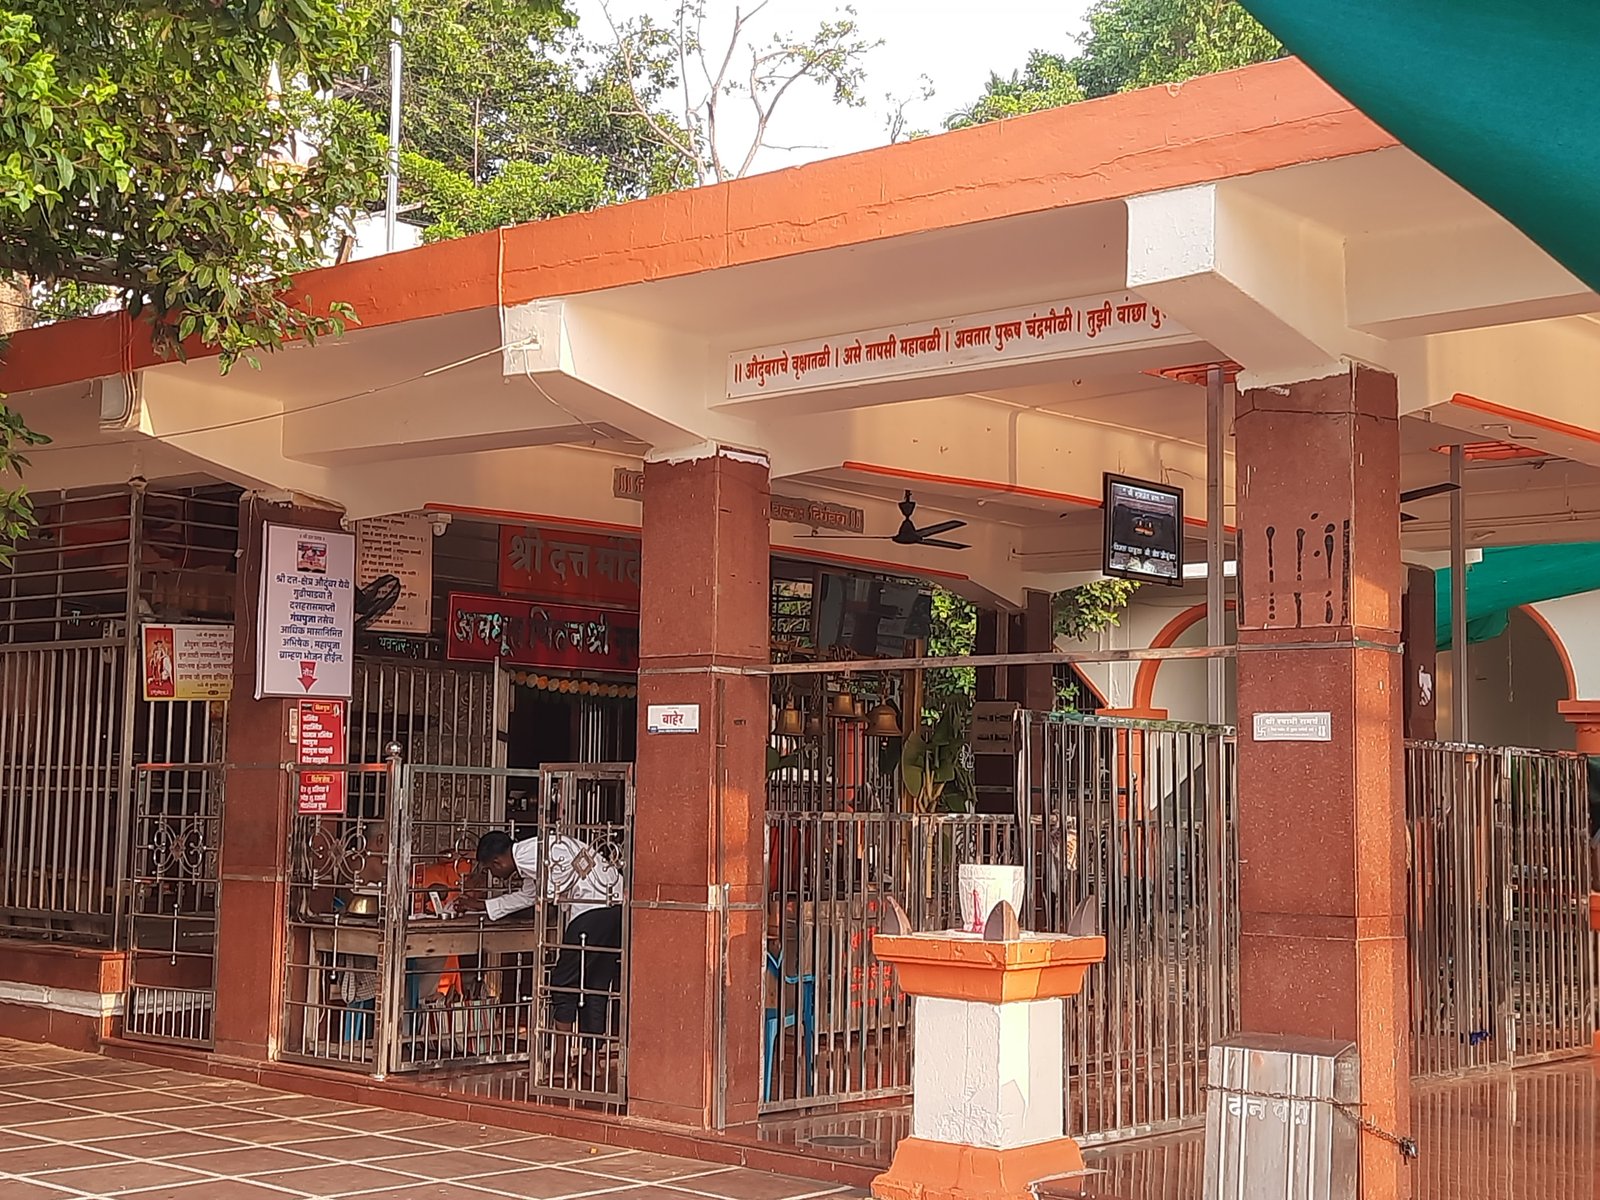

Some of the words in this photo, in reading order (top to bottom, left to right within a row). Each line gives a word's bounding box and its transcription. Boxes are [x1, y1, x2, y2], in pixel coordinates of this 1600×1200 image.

[791, 344, 831, 379] वृक्षातळी
[843, 339, 862, 365] असे
[865, 334, 896, 361] तापसी
[900, 327, 941, 358] महाबळी
[954, 326, 991, 349] अवतार
[1025, 307, 1072, 339] चंद्रमौळी
[1087, 300, 1112, 338] तुझी
[1116, 296, 1147, 325] वांछा
[508, 528, 544, 574] श्री
[548, 541, 591, 581] दत्त
[276, 573, 286, 583] श्री
[327, 589, 332, 599] ते
[317, 614, 334, 624] तसेच
[304, 650, 322, 660] भोजन
[662, 710, 684, 726] बाहेर
[1277, 716, 1298, 725] स्वामी
[1300, 716, 1318, 725] समर्थ
[1228, 1097, 1268, 1121] दान
